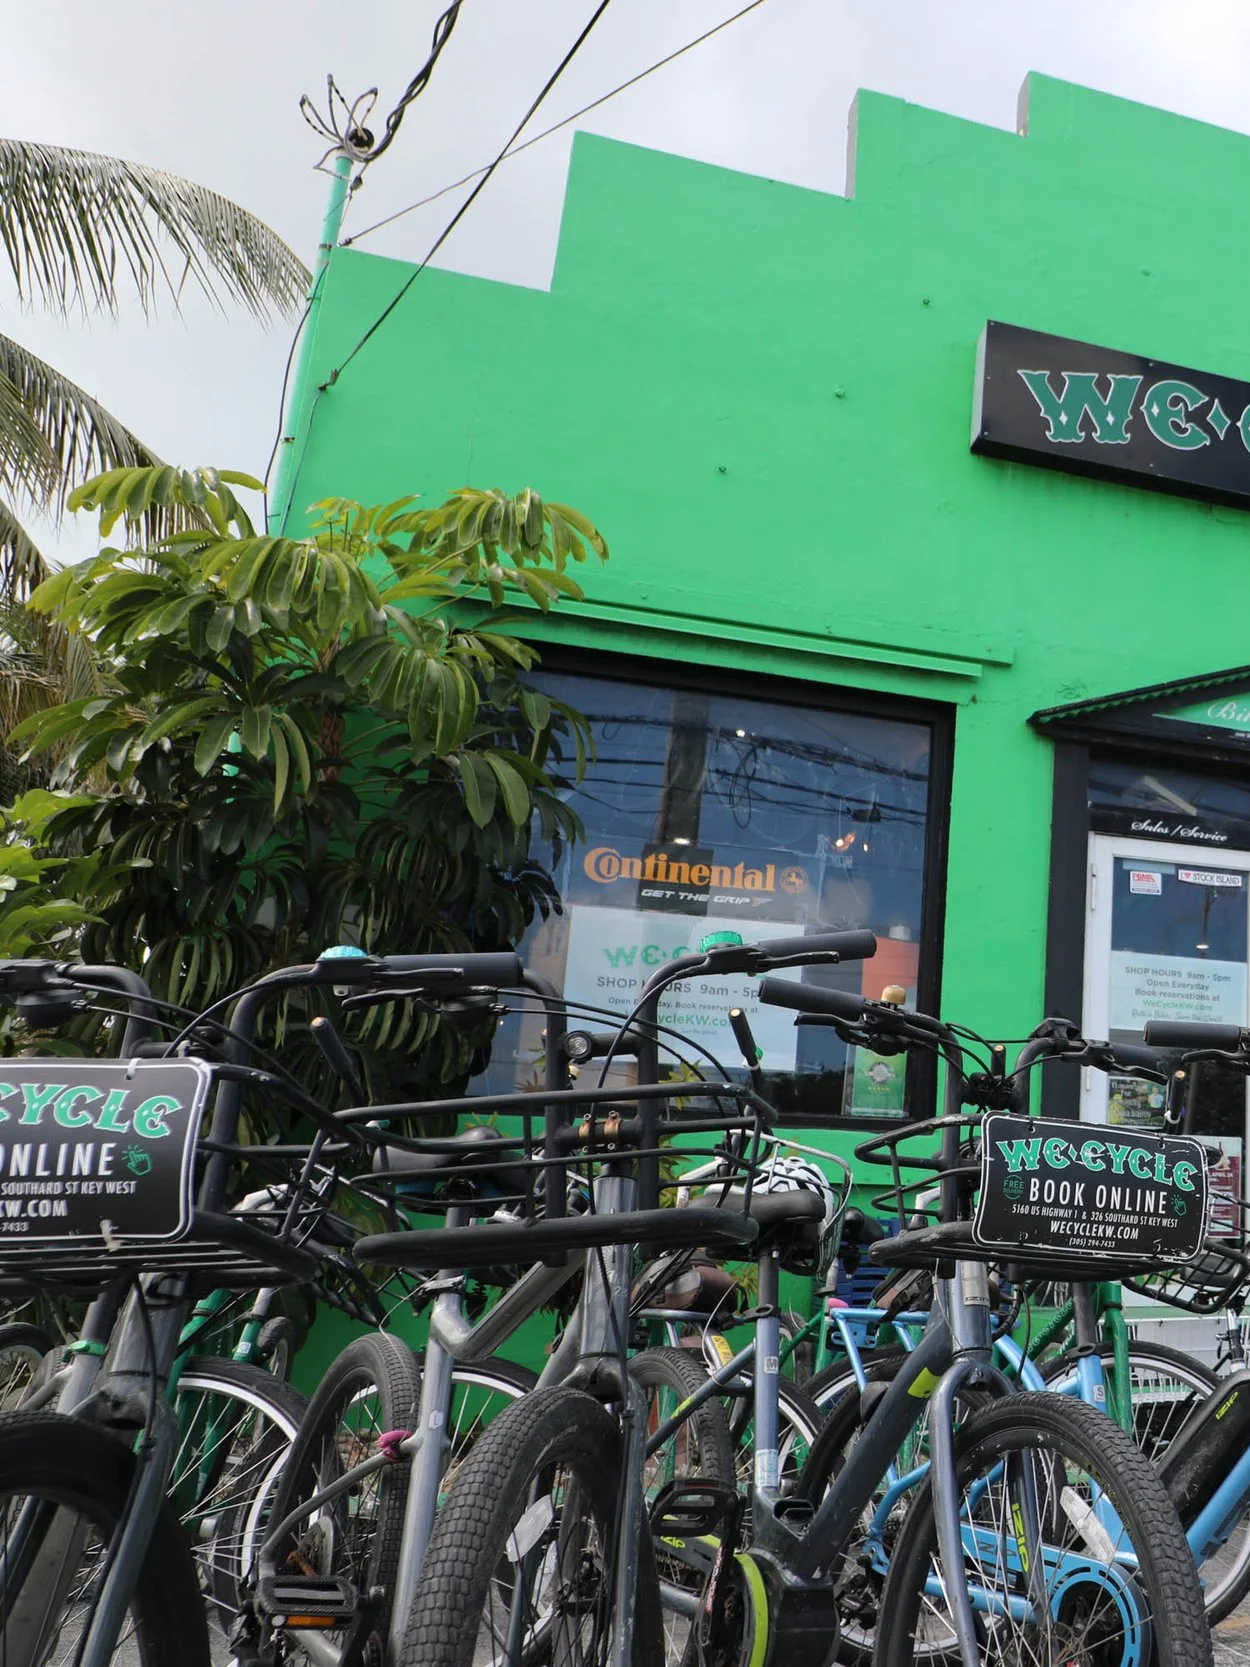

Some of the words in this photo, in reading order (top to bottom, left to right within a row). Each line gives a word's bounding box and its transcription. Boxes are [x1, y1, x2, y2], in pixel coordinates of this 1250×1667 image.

[583, 847, 775, 892] Continental
[1192, 873, 1214, 883] STOCK
[1215, 875, 1240, 885] ISLAND
[641, 889, 675, 898] GET
[678, 892, 710, 901] THE
[713, 895, 750, 905] GRIP
[1152, 968, 1182, 977] HOURS
[1187, 971, 1205, 979] 9am
[1212, 973, 1231, 982] 5pm
[597, 976, 637, 989] SHOP
[642, 979, 691, 993] URS
[700, 984, 729, 997] 9am
[743, 987, 759, 1000] 5p
[1146, 979, 1169, 988] Open
[1172, 980, 1210, 991] Everyday
[1135, 988, 1157, 996] Book
[1159, 991, 1210, 1000] reservations
[608, 997, 631, 1006] Open
[675, 1001, 696, 1010] Book
[750, 1006, 758, 1014] at
[0, 1142, 118, 1177] NLINE
[1, 1181, 63, 1196] SOUTHARD
[65, 1181, 80, 1195] ST
[80, 1181, 104, 1195] KEY
[105, 1181, 138, 1195] WEST
[1003, 1180, 1024, 1189] FREE
[1029, 1177, 1086, 1207] BOOK
[1095, 1184, 1168, 1215] ONLINE
[1011, 1203, 1029, 1214] 5160
[1030, 1206, 1040, 1215] US
[1041, 1206, 1073, 1218] HIGHWAY
[1081, 1211, 1087, 1220] &
[1090, 1211, 1103, 1222] 326
[1104, 1212, 1139, 1224] SOUTHARD
[1140, 1215, 1148, 1225] ST
[1148, 1216, 1161, 1226] KEY
[1161, 1218, 1178, 1228] WEST
[1050, 1220, 1139, 1240] WECYCLEKW.COM
[1069, 1237, 1087, 1247] (305)
[1087, 1238, 1116, 1248] 294-7433
